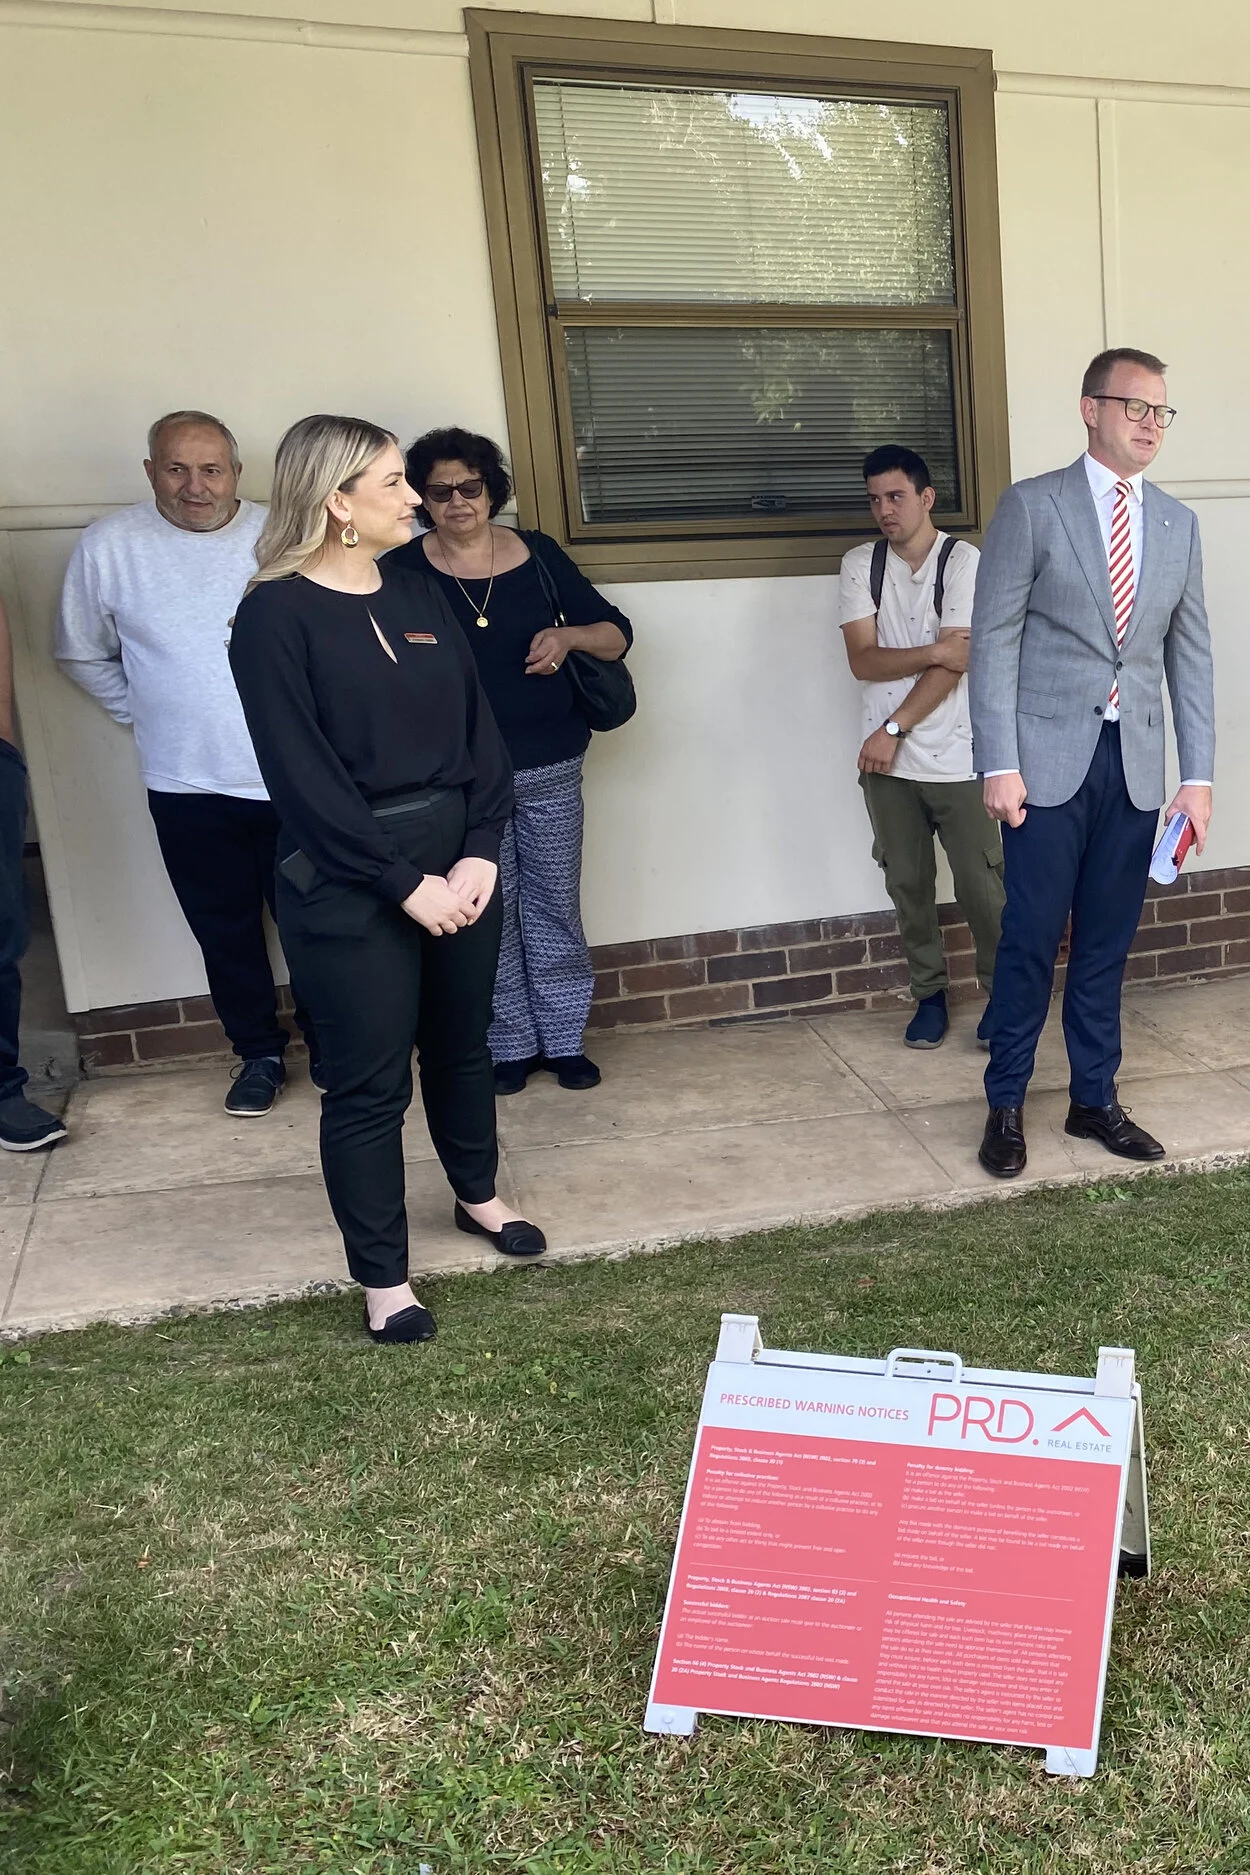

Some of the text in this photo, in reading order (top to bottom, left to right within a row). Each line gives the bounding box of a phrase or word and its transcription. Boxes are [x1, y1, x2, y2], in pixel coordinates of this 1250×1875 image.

[720, 1393, 909, 1421] PRESCRIBED WARNING NOTICES
[1047, 1439, 1112, 1453] REAL ESTATE
